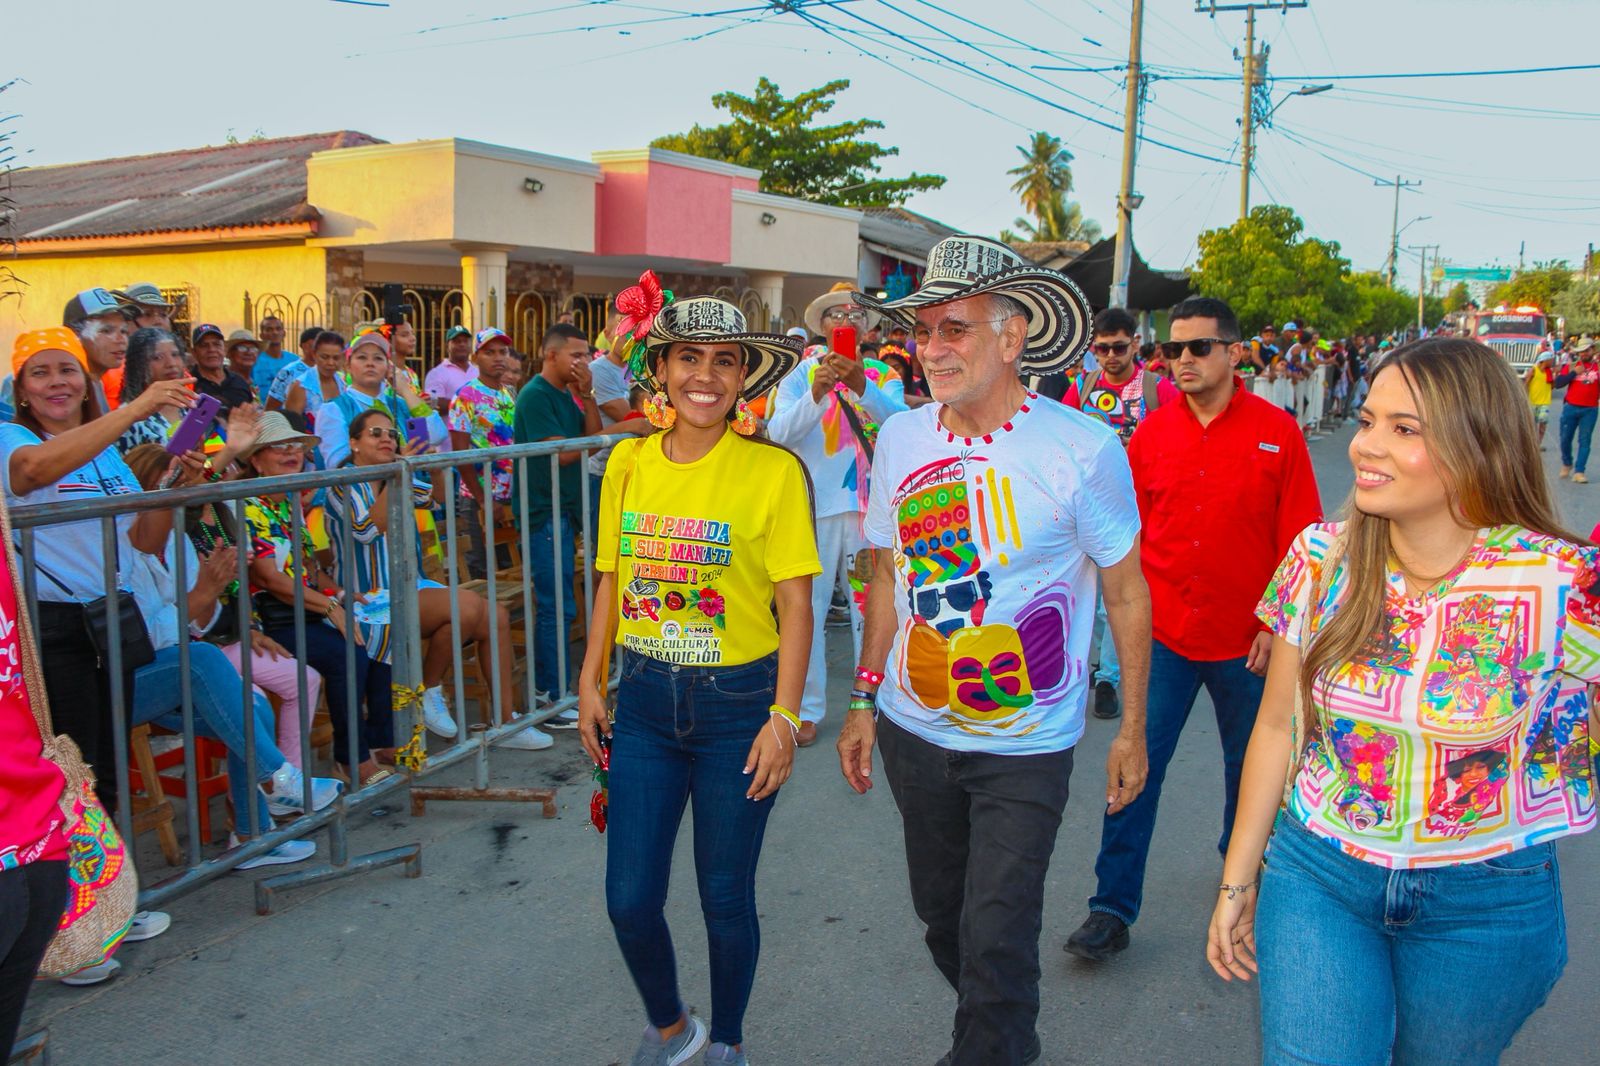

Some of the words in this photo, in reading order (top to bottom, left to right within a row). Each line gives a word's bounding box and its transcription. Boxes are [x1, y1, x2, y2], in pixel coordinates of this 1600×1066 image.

[659, 516, 731, 545] PARADA
[636, 538, 666, 561] SUR
[625, 634, 640, 645] POR
[642, 637, 660, 649] MÁS
[662, 639, 709, 650] CULTURA
[712, 639, 721, 649] Y
